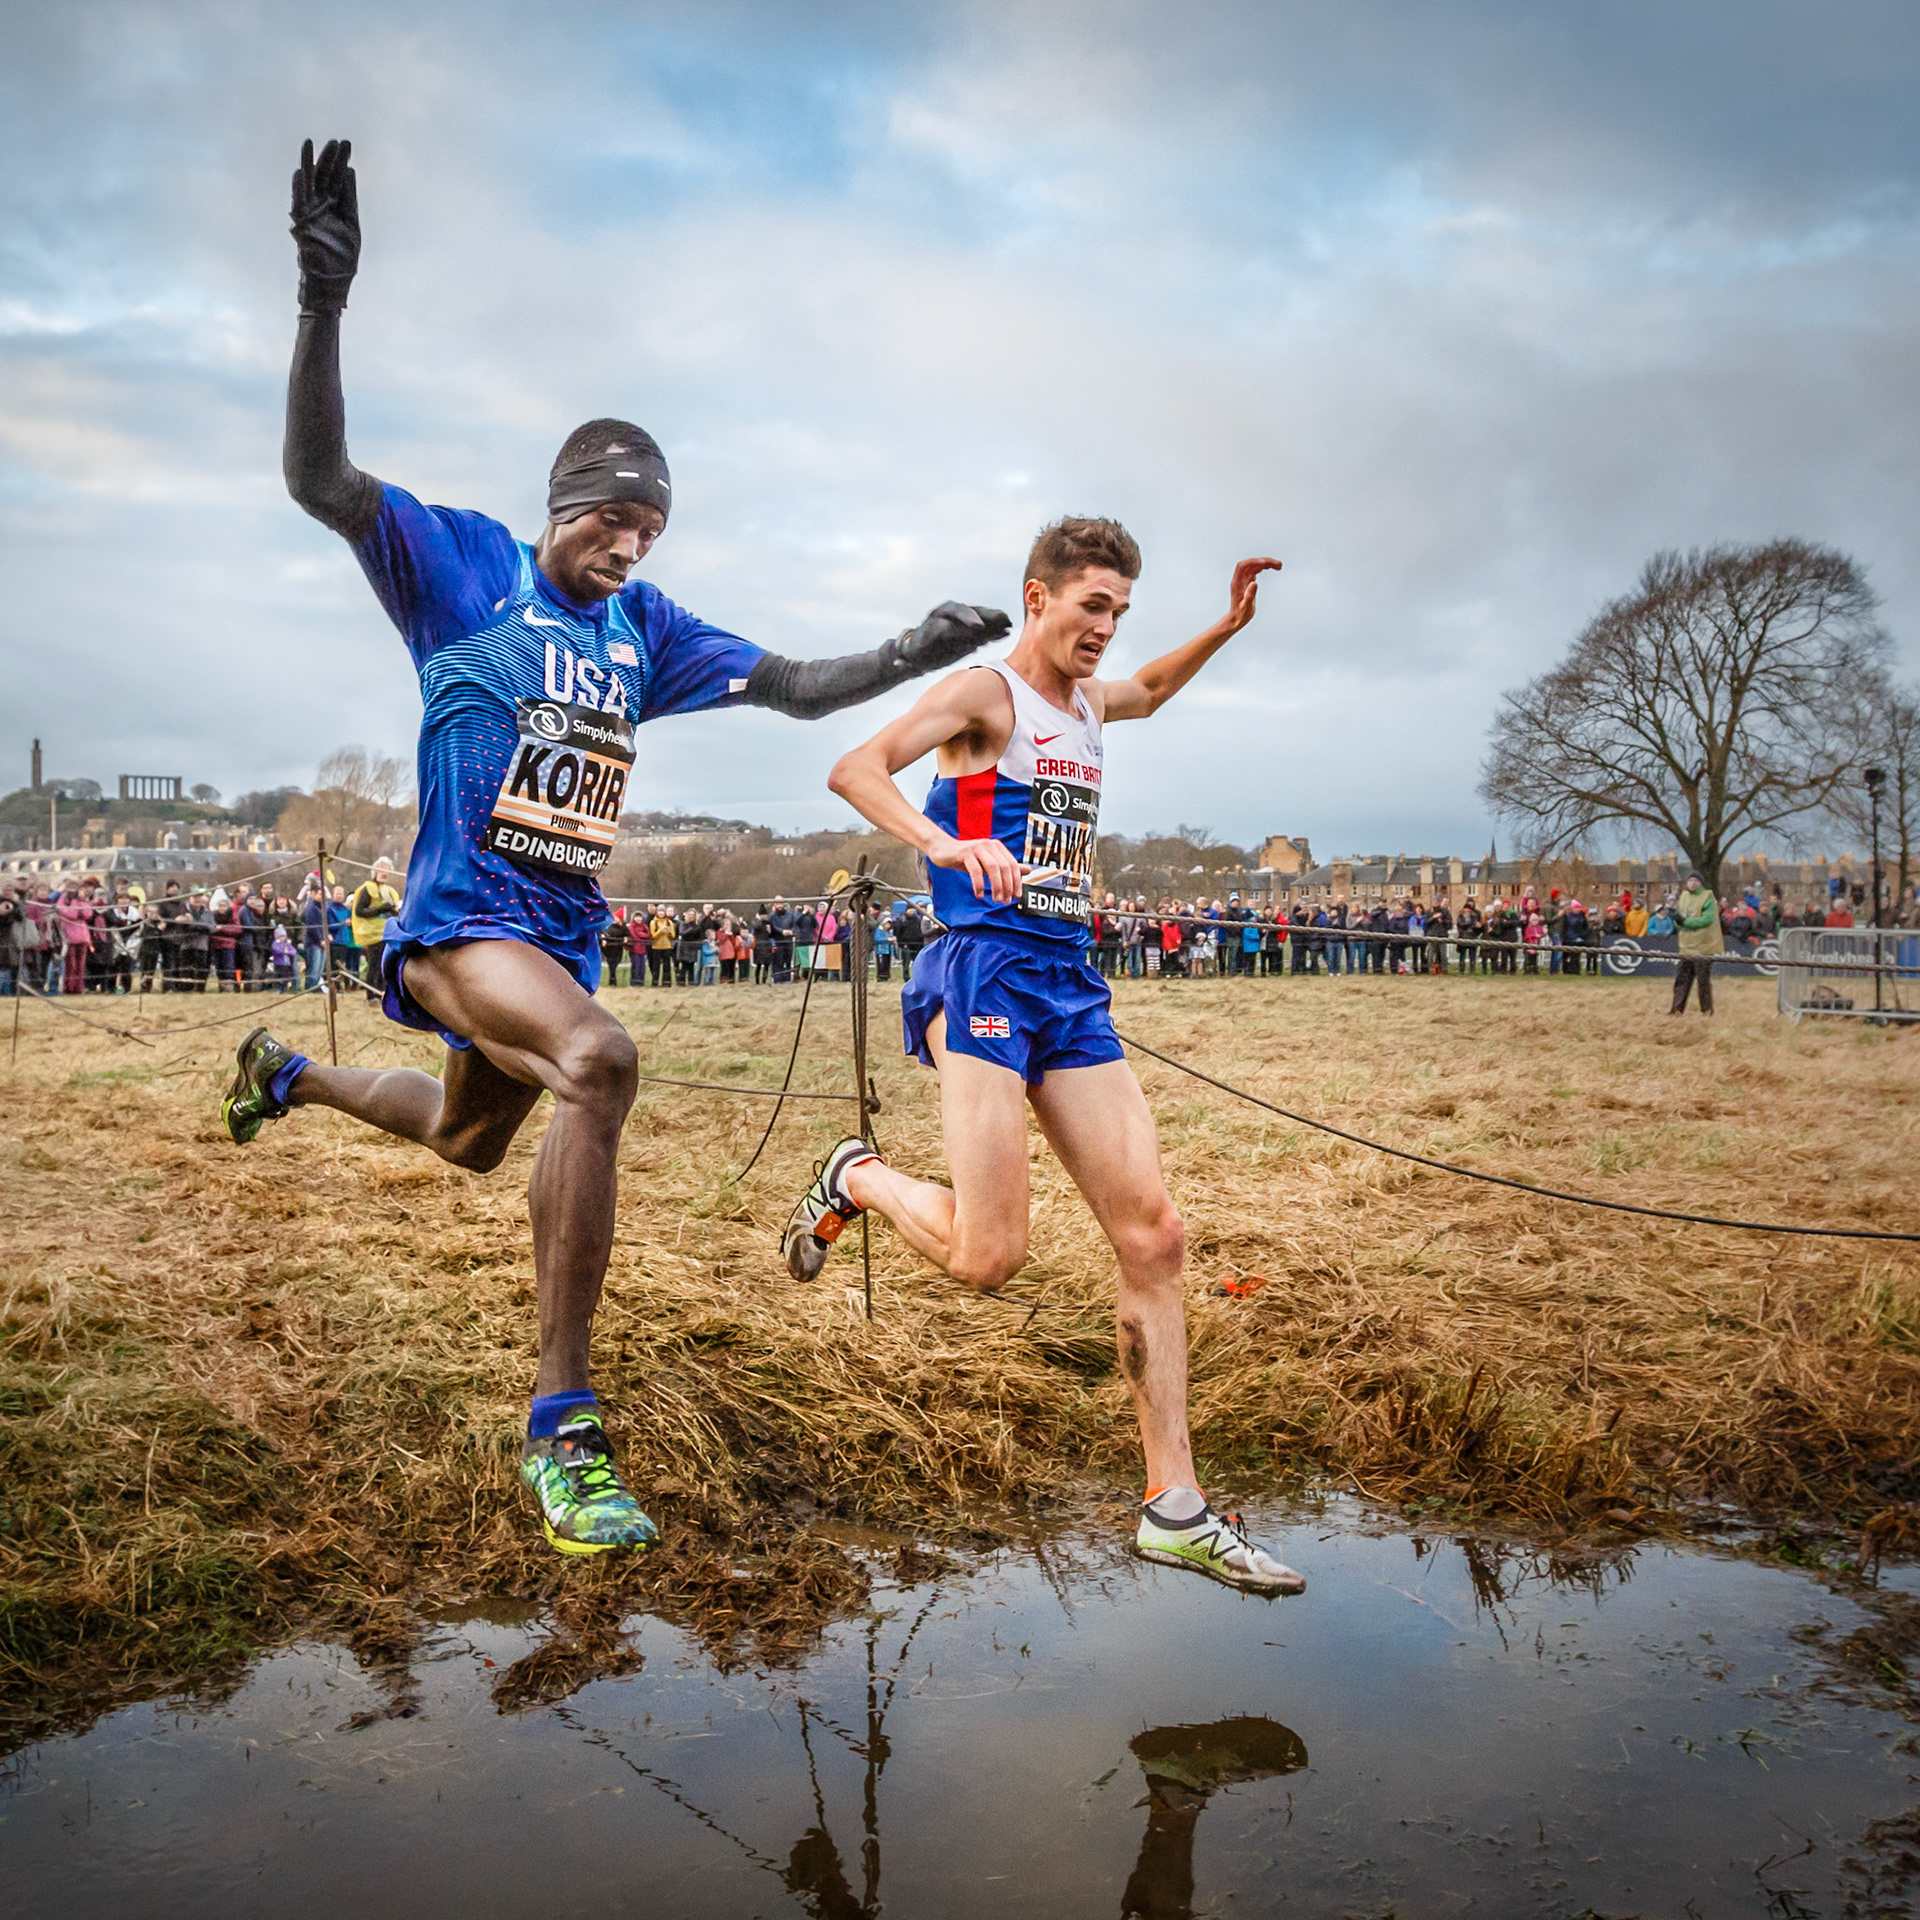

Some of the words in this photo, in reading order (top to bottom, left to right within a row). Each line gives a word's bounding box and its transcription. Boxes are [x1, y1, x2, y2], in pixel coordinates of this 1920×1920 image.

[544, 640, 628, 719] USA
[508, 743, 626, 823] KORIR
[1036, 758, 1080, 779] GREAT
[550, 814, 580, 833] PUMA
[494, 826, 606, 871] EDINBURGH
